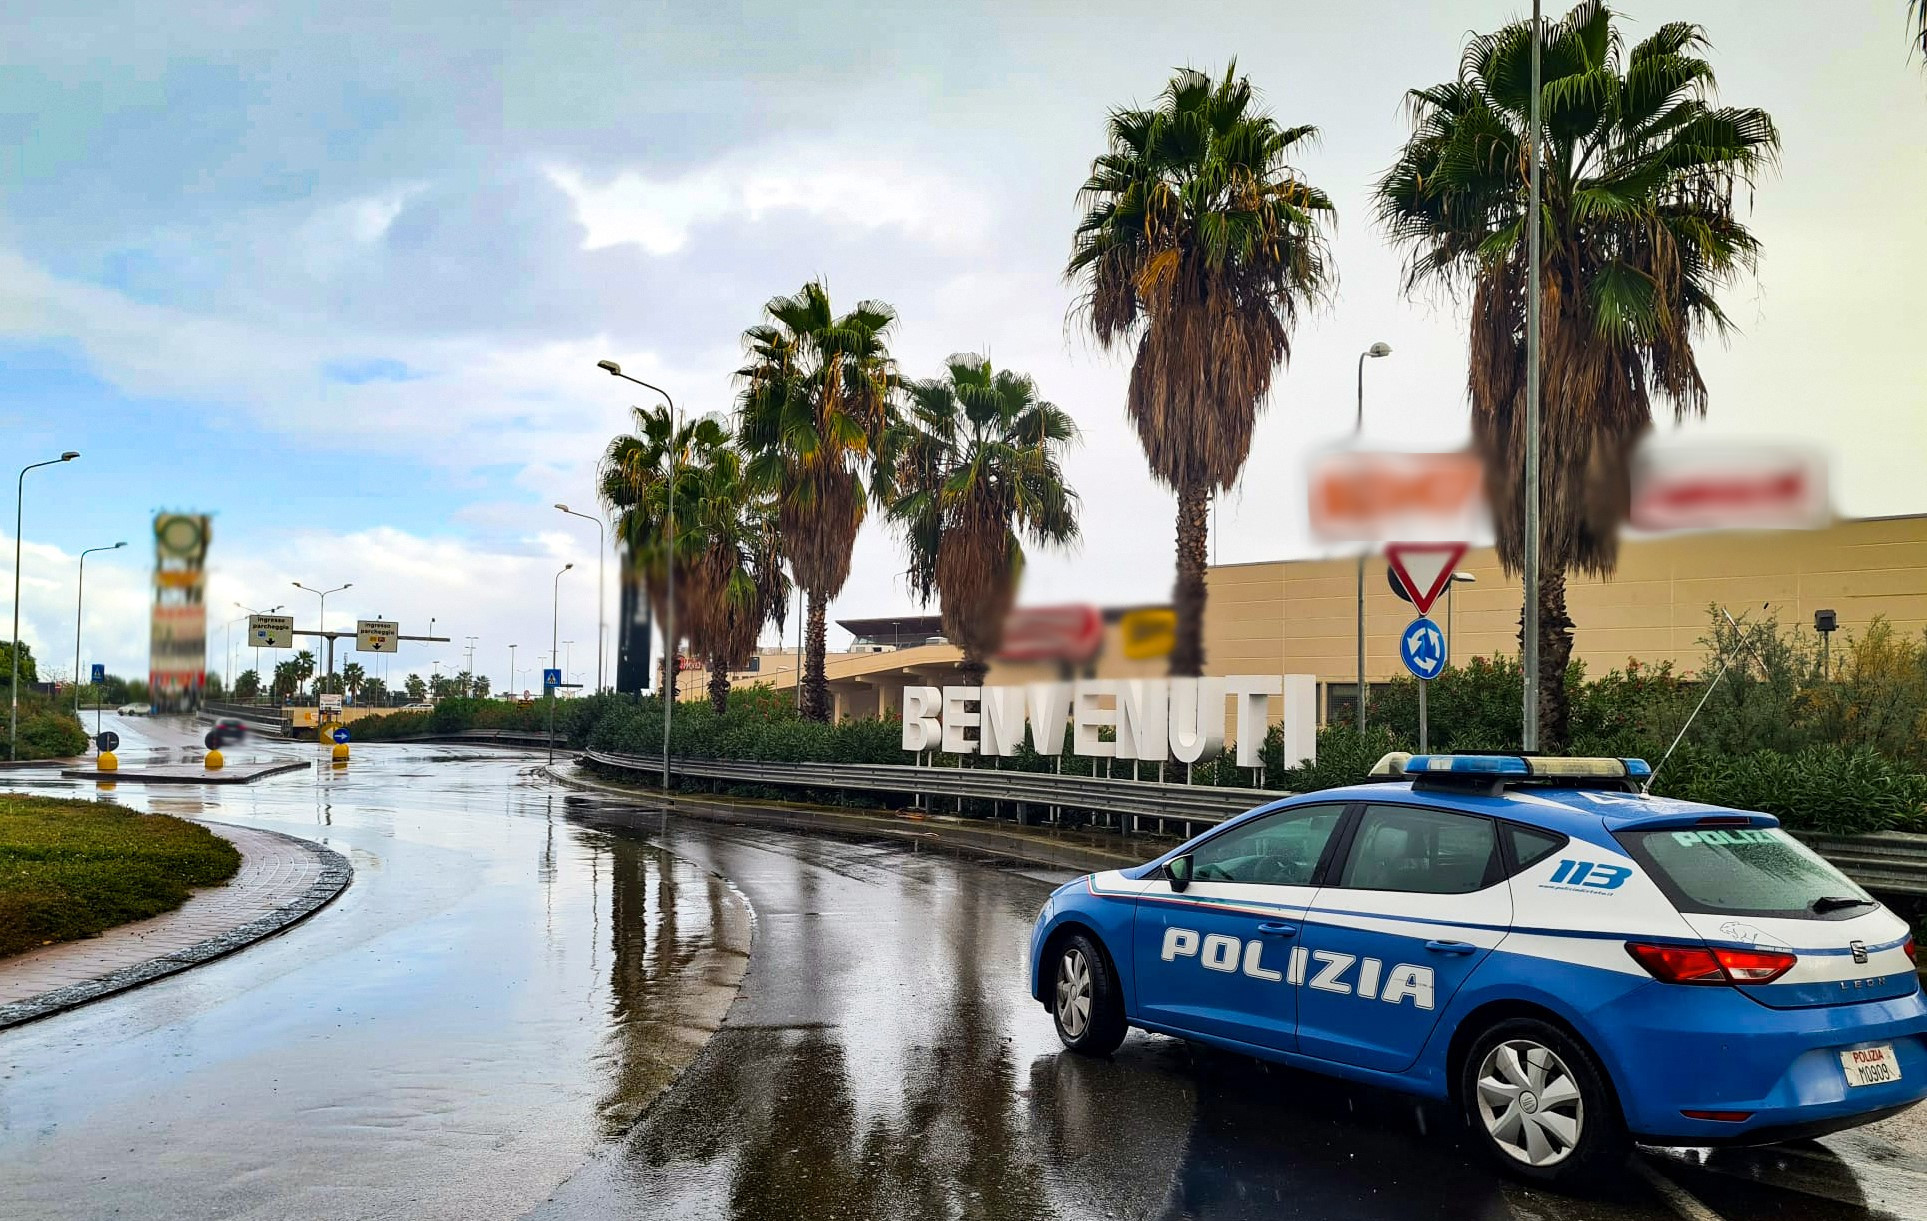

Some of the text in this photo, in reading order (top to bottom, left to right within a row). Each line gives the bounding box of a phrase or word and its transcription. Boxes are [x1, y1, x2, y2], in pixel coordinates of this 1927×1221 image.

[902, 673, 1317, 772] BENVENUTI
[1549, 859, 1633, 890] 113
[1160, 926, 1436, 1011] POLIZIA
[1840, 977, 1886, 990] LEON
[1853, 1049, 1884, 1064] POLIZIA
[1858, 1063, 1890, 1084] M0909
